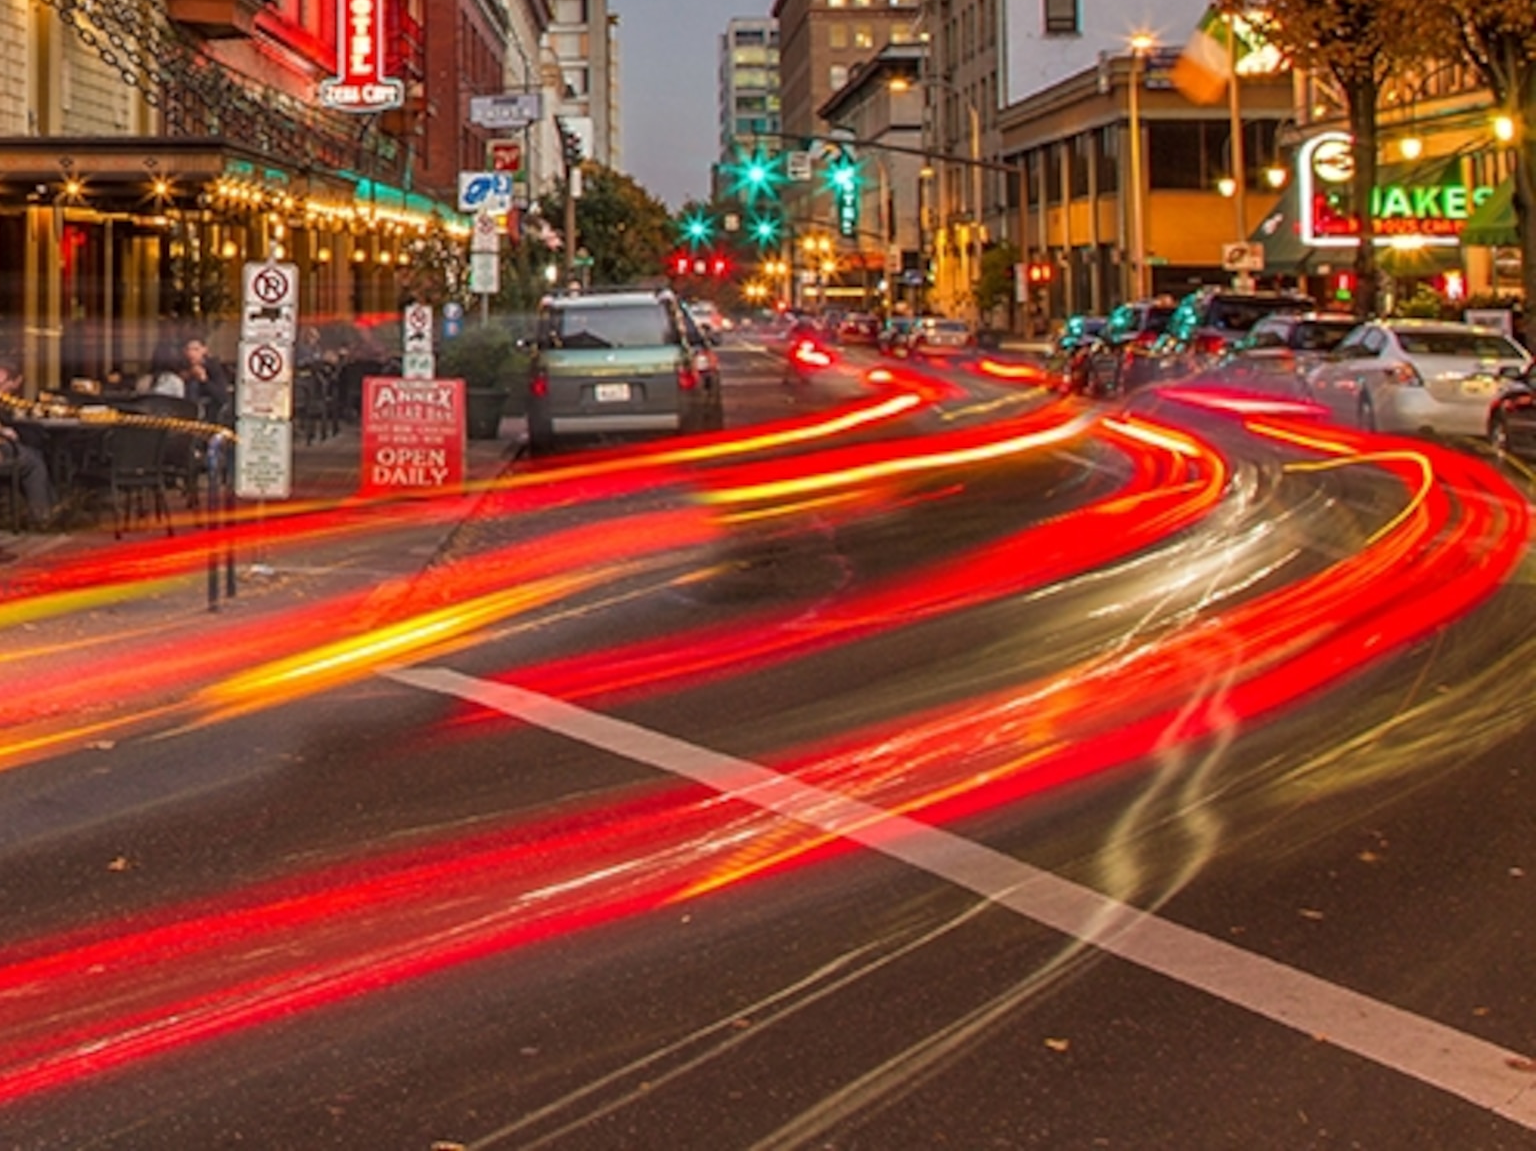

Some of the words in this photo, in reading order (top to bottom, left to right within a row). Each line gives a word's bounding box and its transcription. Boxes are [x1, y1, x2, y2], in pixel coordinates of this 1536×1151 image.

[374, 387, 452, 409] ANNEX
[376, 448, 446, 467] OPEN
[372, 467, 449, 486] DAILY
